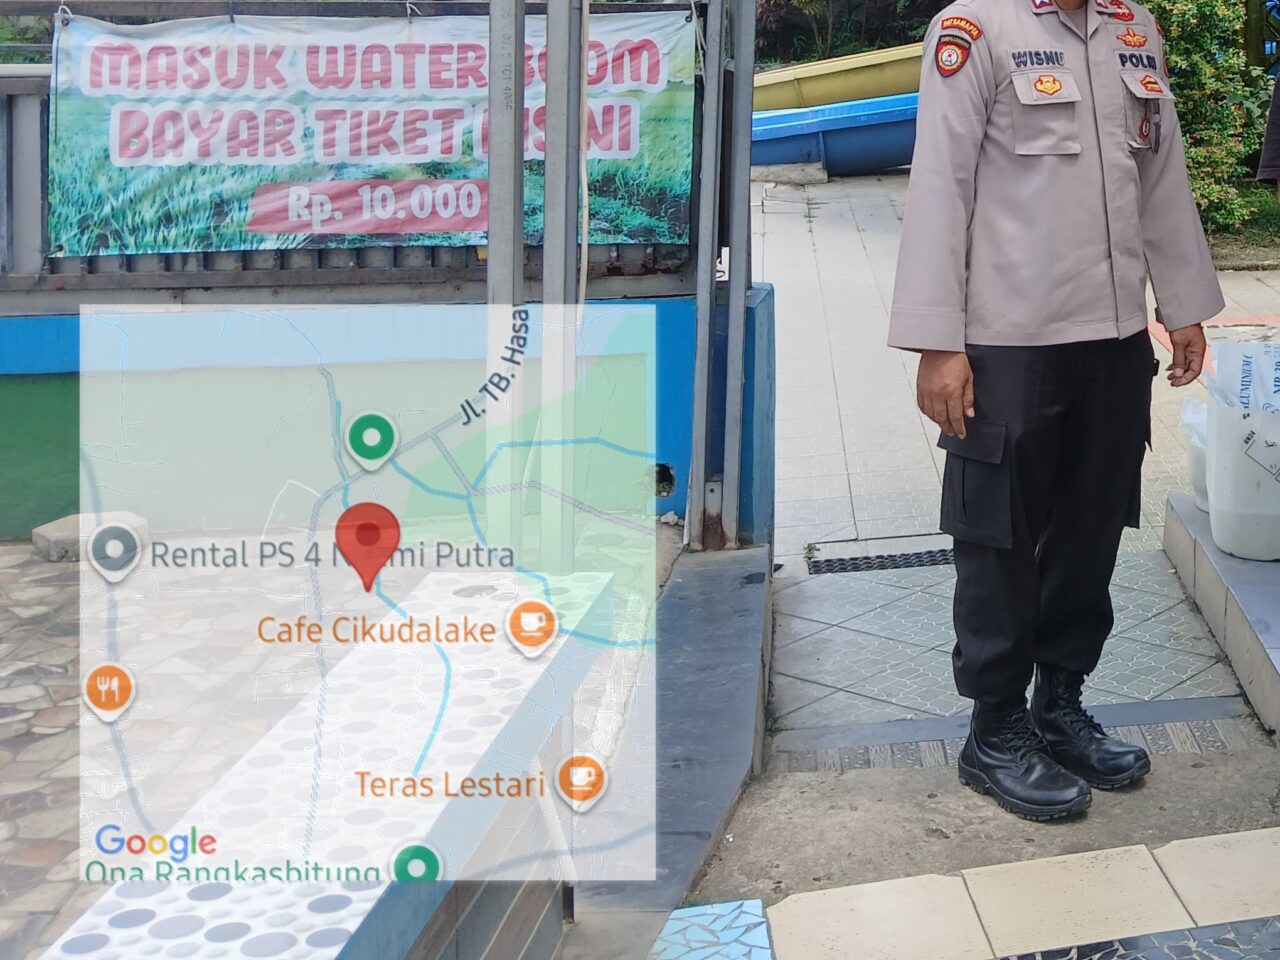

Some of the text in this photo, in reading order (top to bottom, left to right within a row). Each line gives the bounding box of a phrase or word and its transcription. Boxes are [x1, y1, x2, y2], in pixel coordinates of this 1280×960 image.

[89, 42, 288, 90] MASUK
[1012, 50, 1064, 68] WISNU
[1119, 52, 1157, 70] POLRI
[117, 108, 301, 159] BAYAR
[314, 108, 466, 157] TIKET
[288, 183, 481, 230] Rp. 10.000
